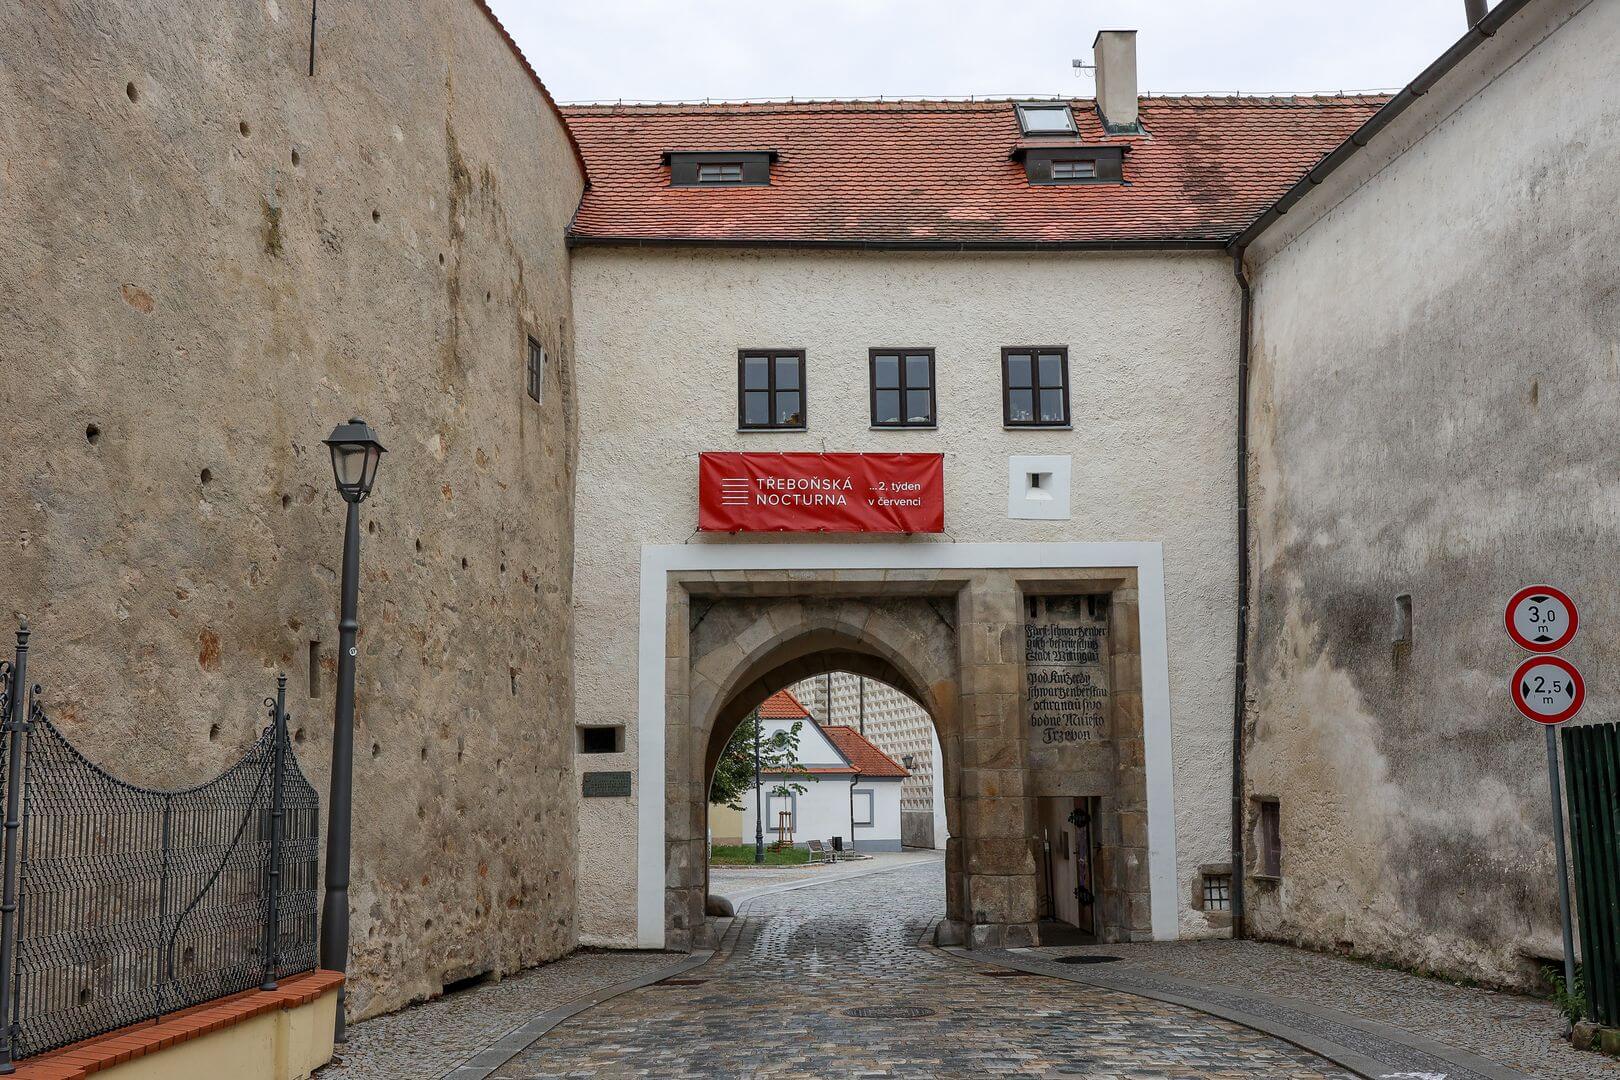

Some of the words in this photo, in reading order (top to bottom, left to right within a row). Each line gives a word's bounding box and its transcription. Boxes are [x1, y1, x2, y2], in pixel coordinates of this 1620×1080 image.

[756, 476, 853, 490] TŘEBOŇSKÁ
[891, 481, 921, 493] týden
[756, 494, 847, 506] NOCTURNA
[877, 496, 921, 506] červenci
[1528, 606, 1556, 623] 3,0
[1533, 676, 1561, 694] 2,5
[1542, 696, 1554, 704] m
